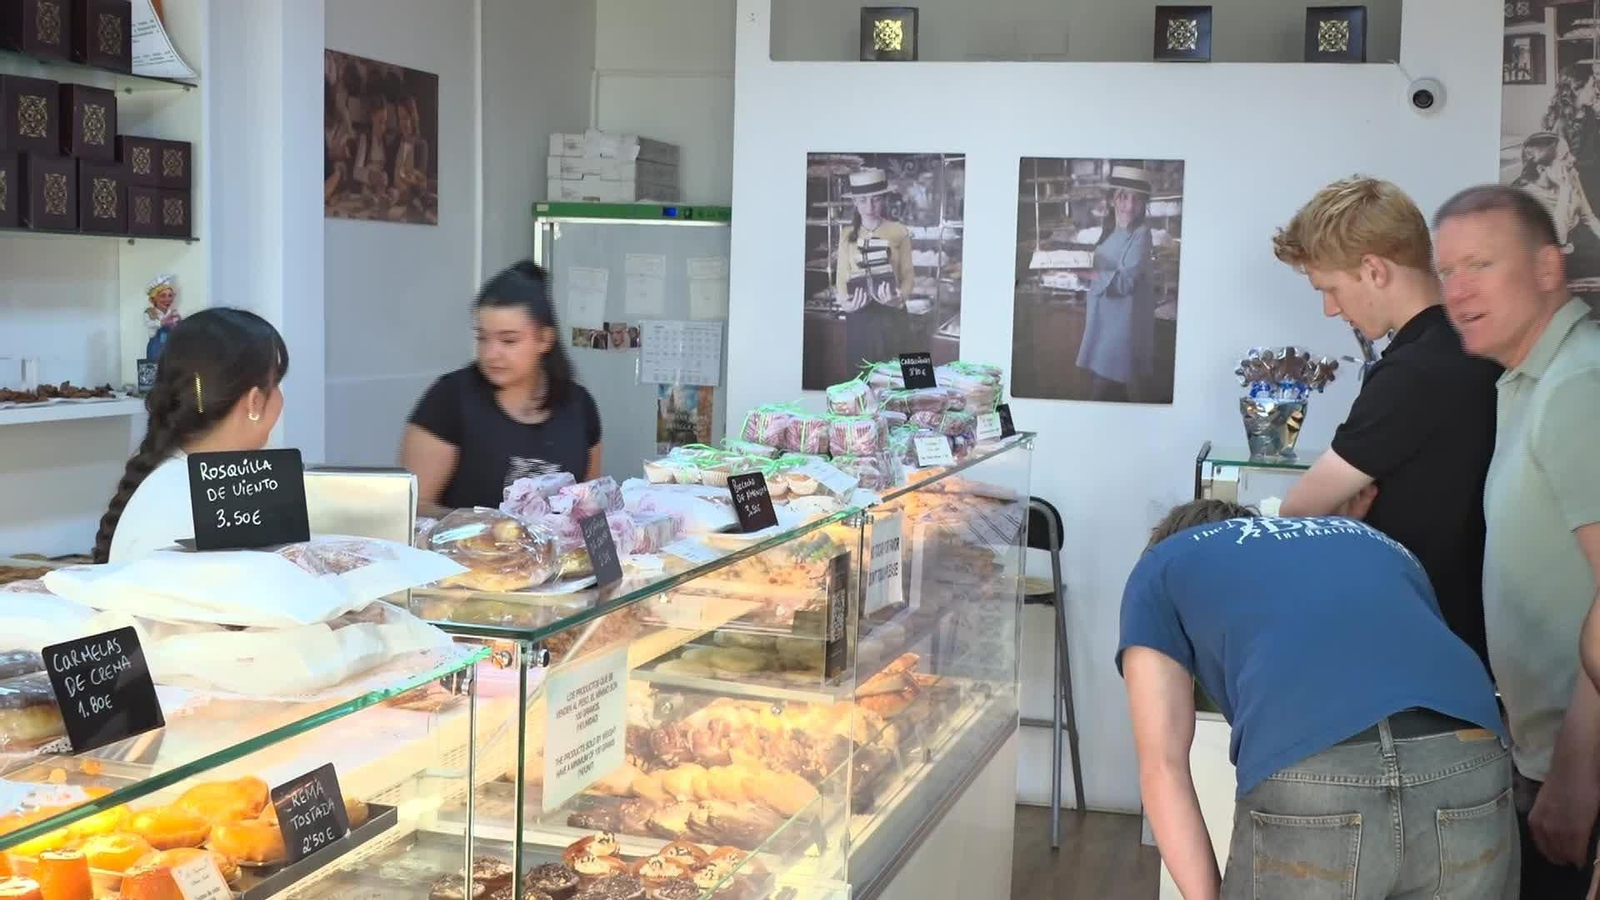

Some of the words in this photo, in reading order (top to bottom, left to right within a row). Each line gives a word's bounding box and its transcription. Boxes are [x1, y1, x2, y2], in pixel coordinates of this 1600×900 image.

[200, 459, 272, 480] ROSQUILLA
[206, 486, 226, 501] DE
[216, 508, 262, 528] 3.50€
[1274, 530, 1300, 540] THE
[1305, 527, 1363, 537] HEALTHY
[64, 674, 86, 698] DE
[90, 655, 132, 685] CREMA
[78, 694, 113, 718] 1.80€
[285, 780, 324, 813] REMA
